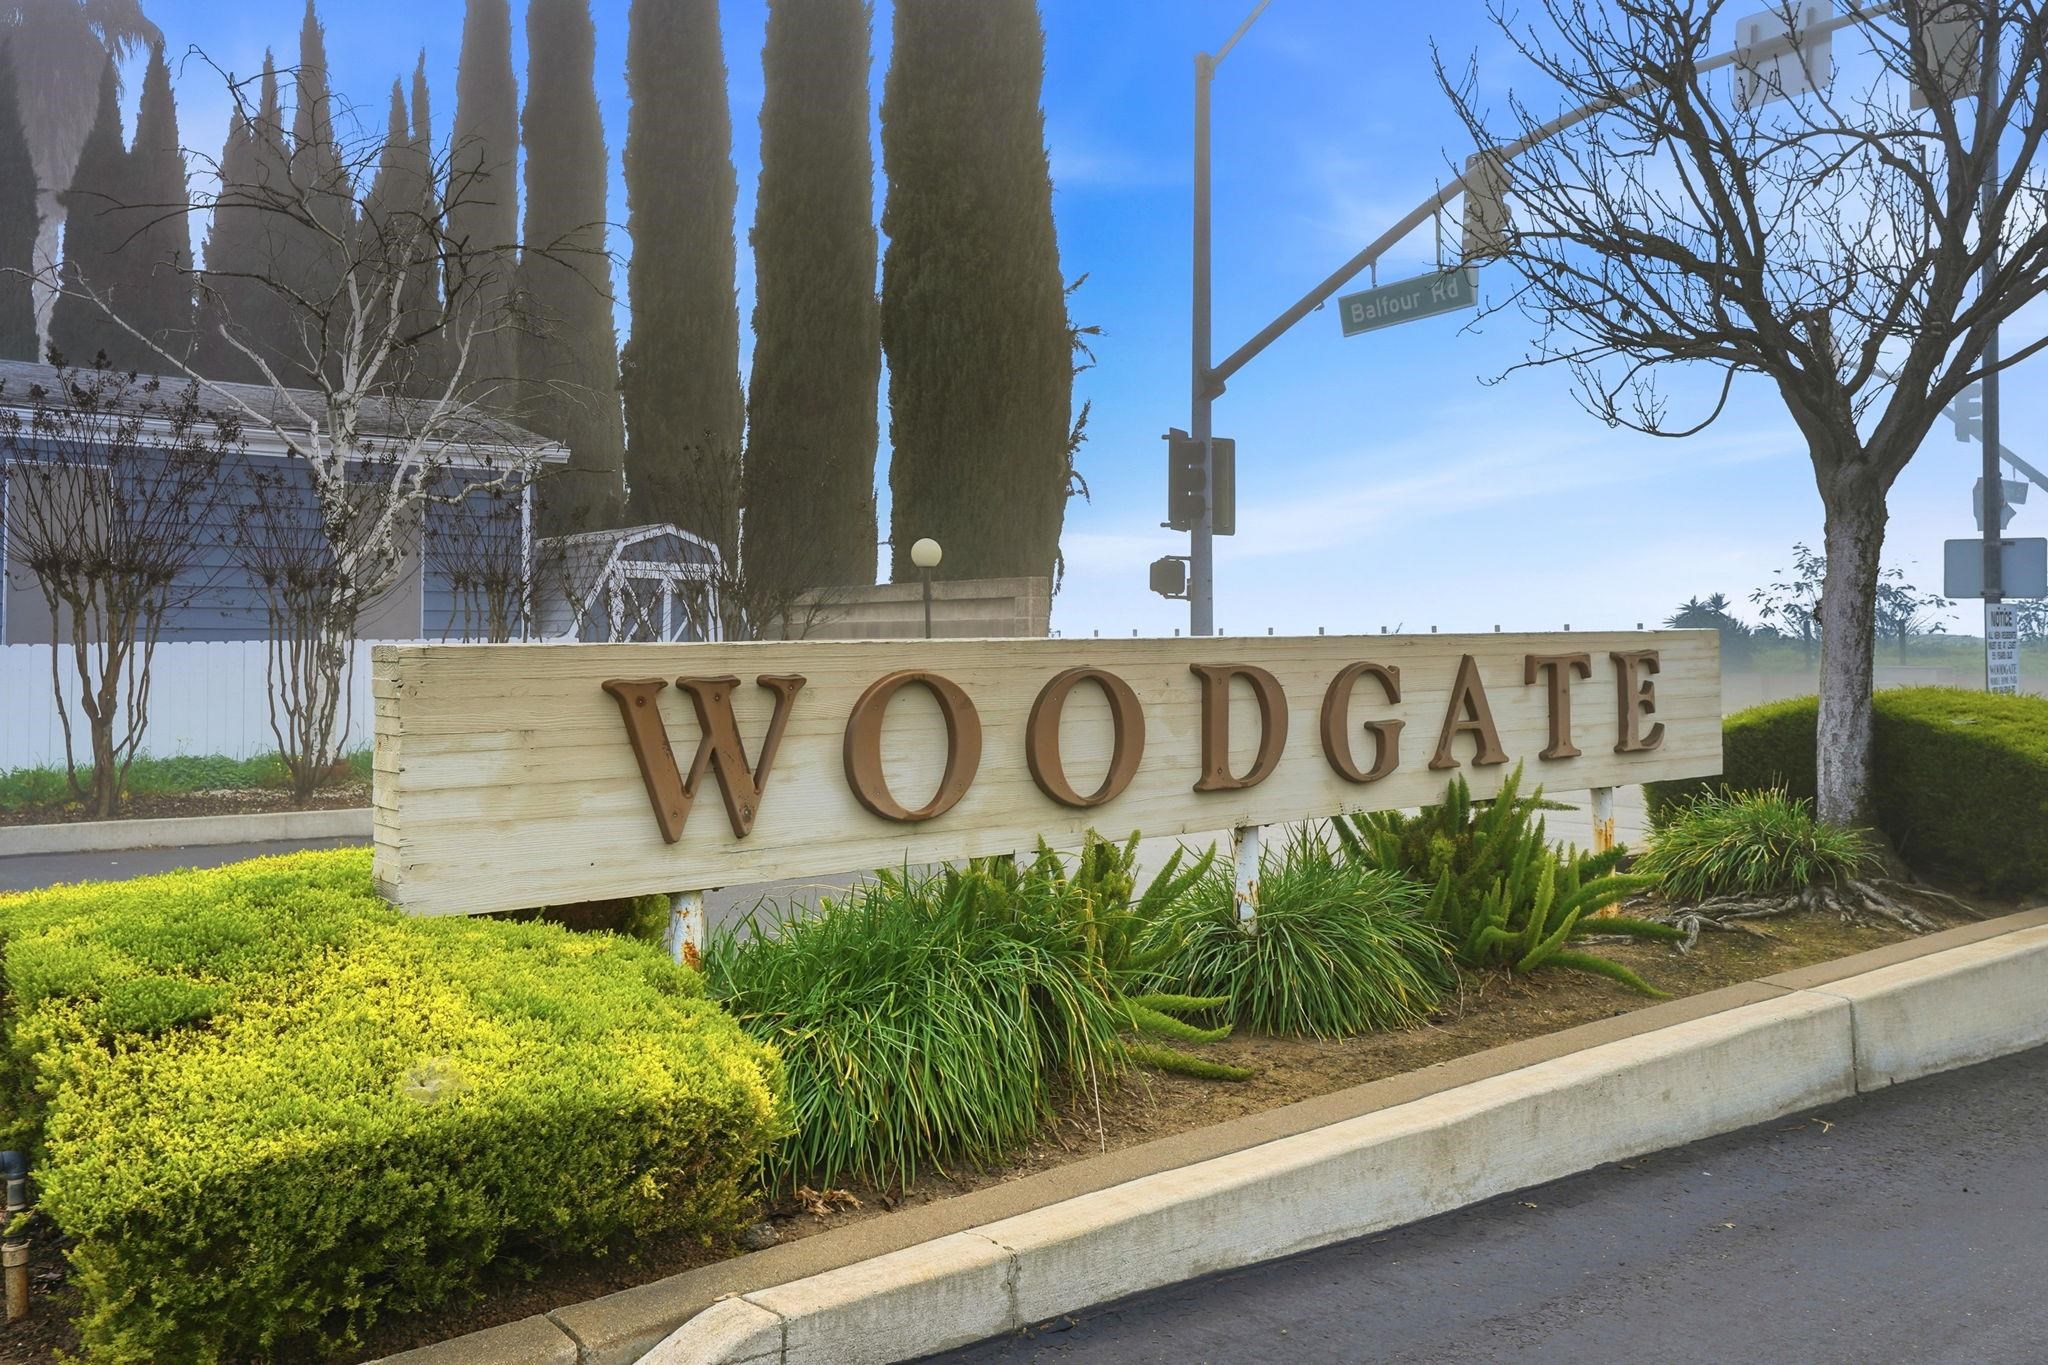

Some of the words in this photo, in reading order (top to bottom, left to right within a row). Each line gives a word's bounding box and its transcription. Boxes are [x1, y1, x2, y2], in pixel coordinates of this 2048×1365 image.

[1351, 292, 1420, 323] Balfour
[1431, 278, 1458, 303] Rd
[601, 649, 1665, 844] WOODGATE
